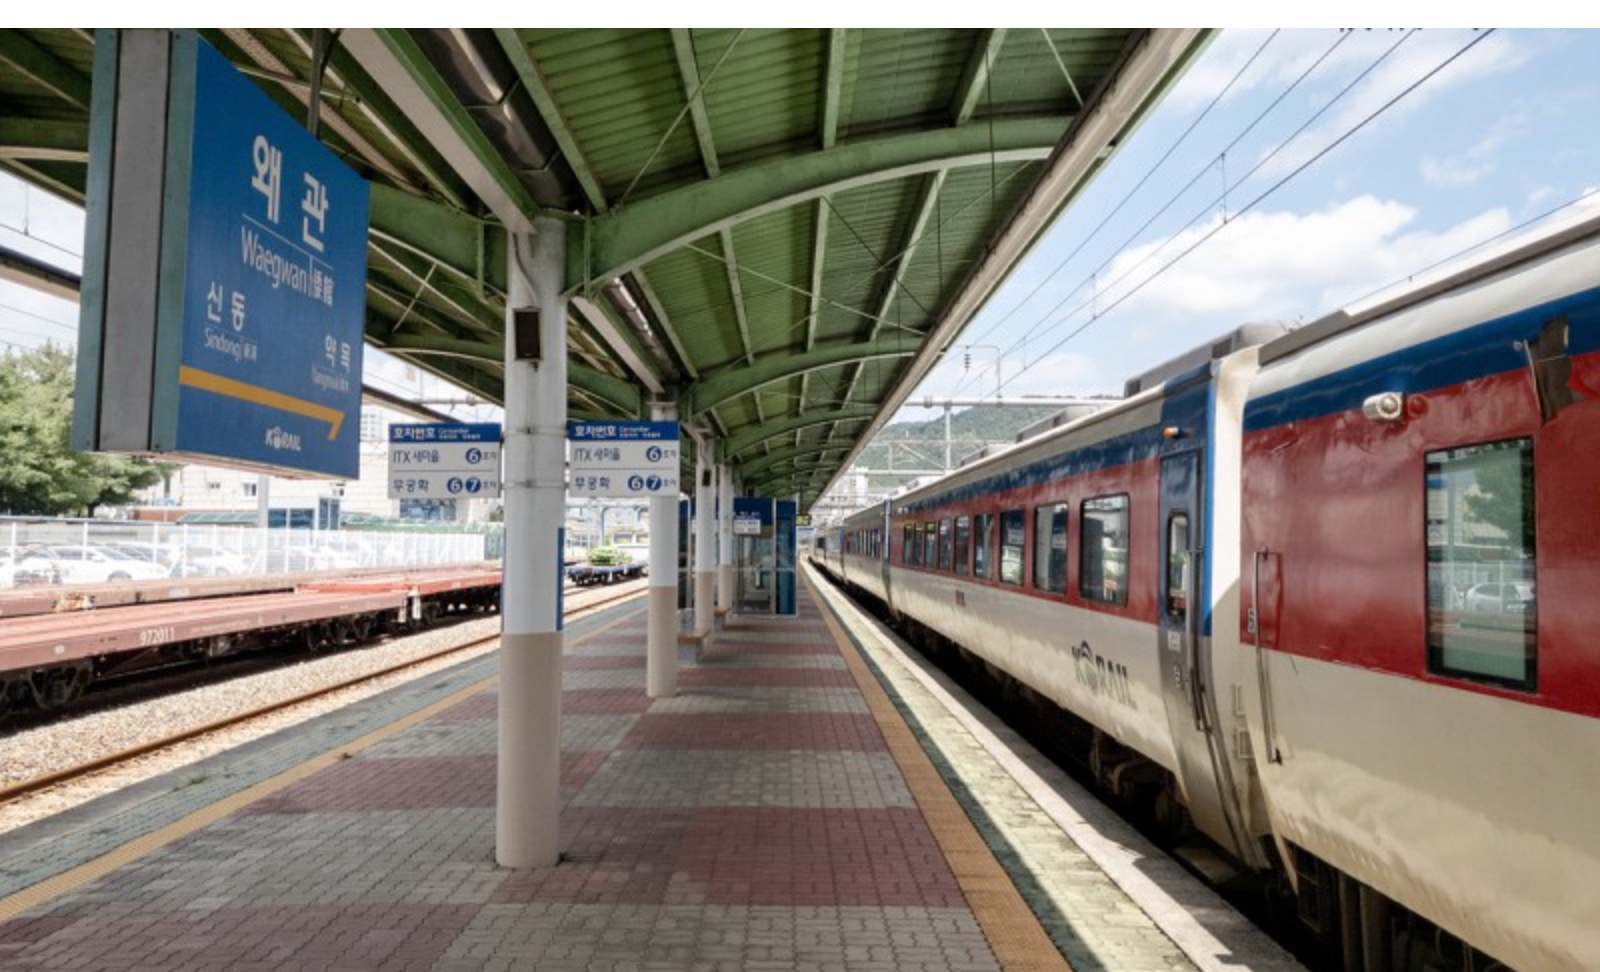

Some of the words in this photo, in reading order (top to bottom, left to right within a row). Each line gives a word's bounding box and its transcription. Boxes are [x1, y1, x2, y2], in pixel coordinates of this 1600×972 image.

[241, 226, 307, 294] Waegwan
[393, 450, 411, 463] ITX
[468, 449, 480, 463] 6
[575, 448, 592, 461] ITX
[648, 447, 660, 461] 6
[449, 479, 461, 492] 6
[630, 477, 642, 491] 6
[139, 627, 176, 646] 972011
